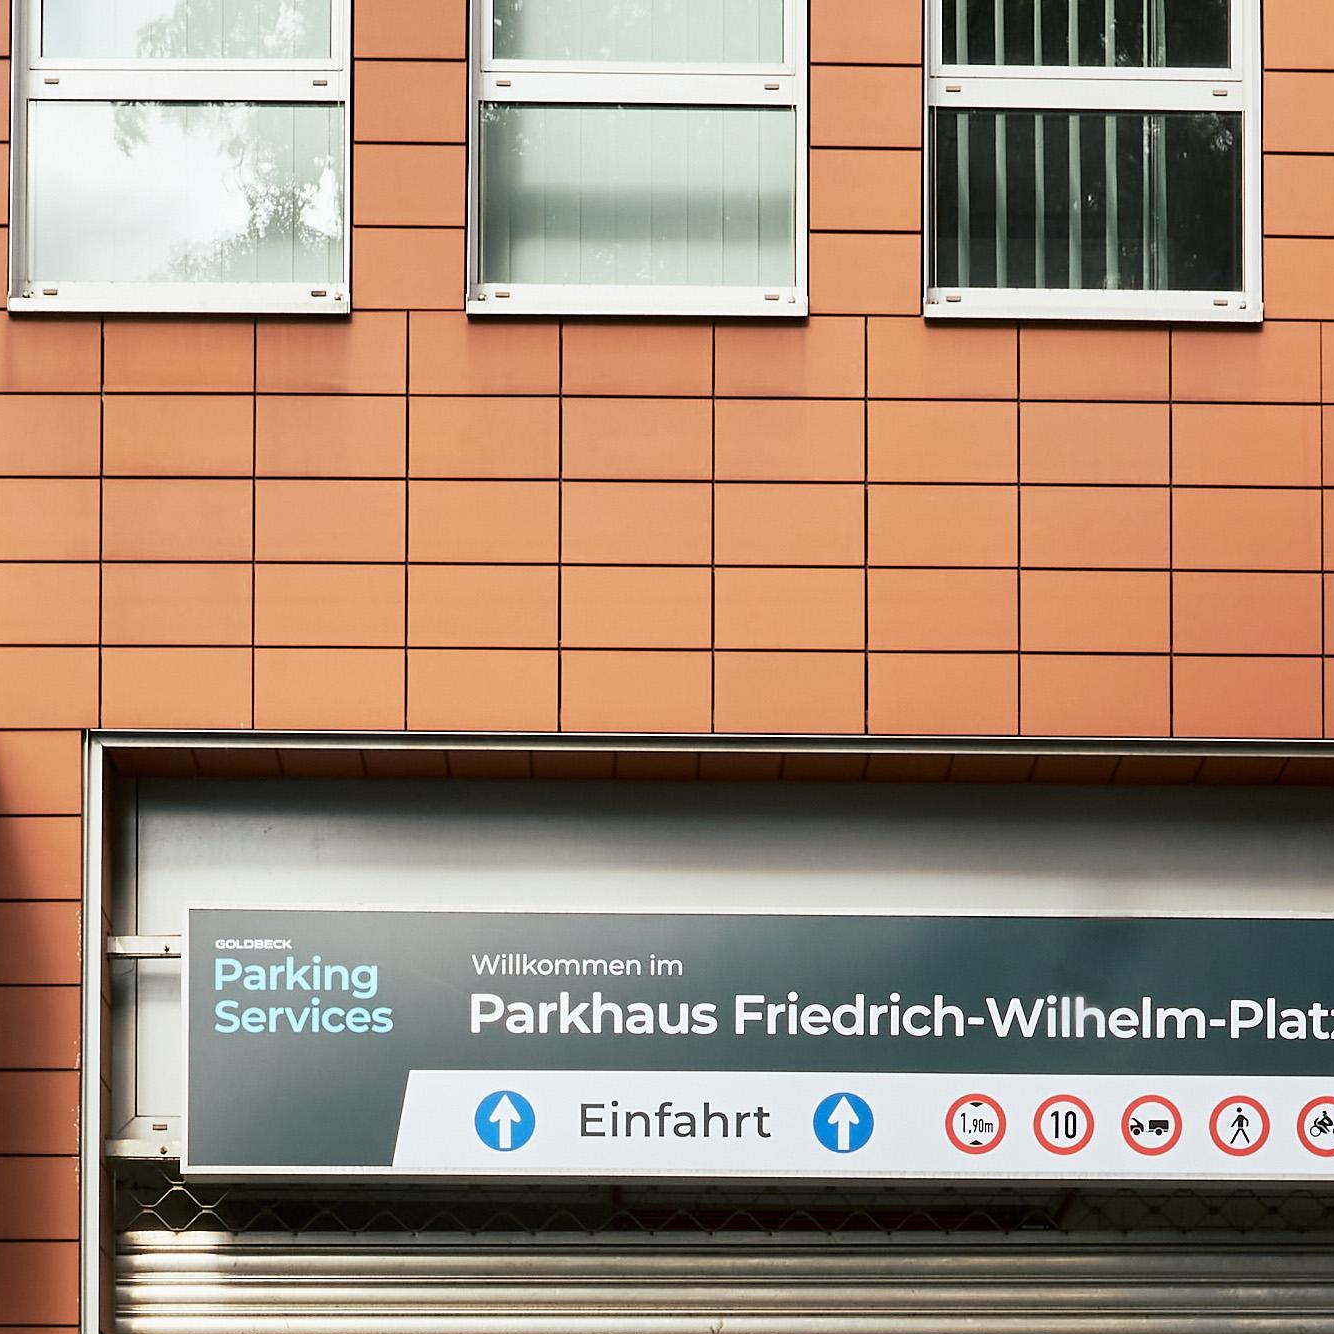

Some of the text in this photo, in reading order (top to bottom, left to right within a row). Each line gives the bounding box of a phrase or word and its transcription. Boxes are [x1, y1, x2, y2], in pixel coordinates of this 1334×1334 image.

[215, 938, 293, 950] GOLDBECK
[214, 955, 379, 1000] Parking
[471, 953, 684, 977] Willkommen im
[214, 997, 395, 1034] Services
[470, 991, 718, 1036] Parkhaus
[579, 1100, 772, 1138] Einfahrt
[960, 1112, 994, 1134] 1,90m
[1050, 1110, 1077, 1139] 10
